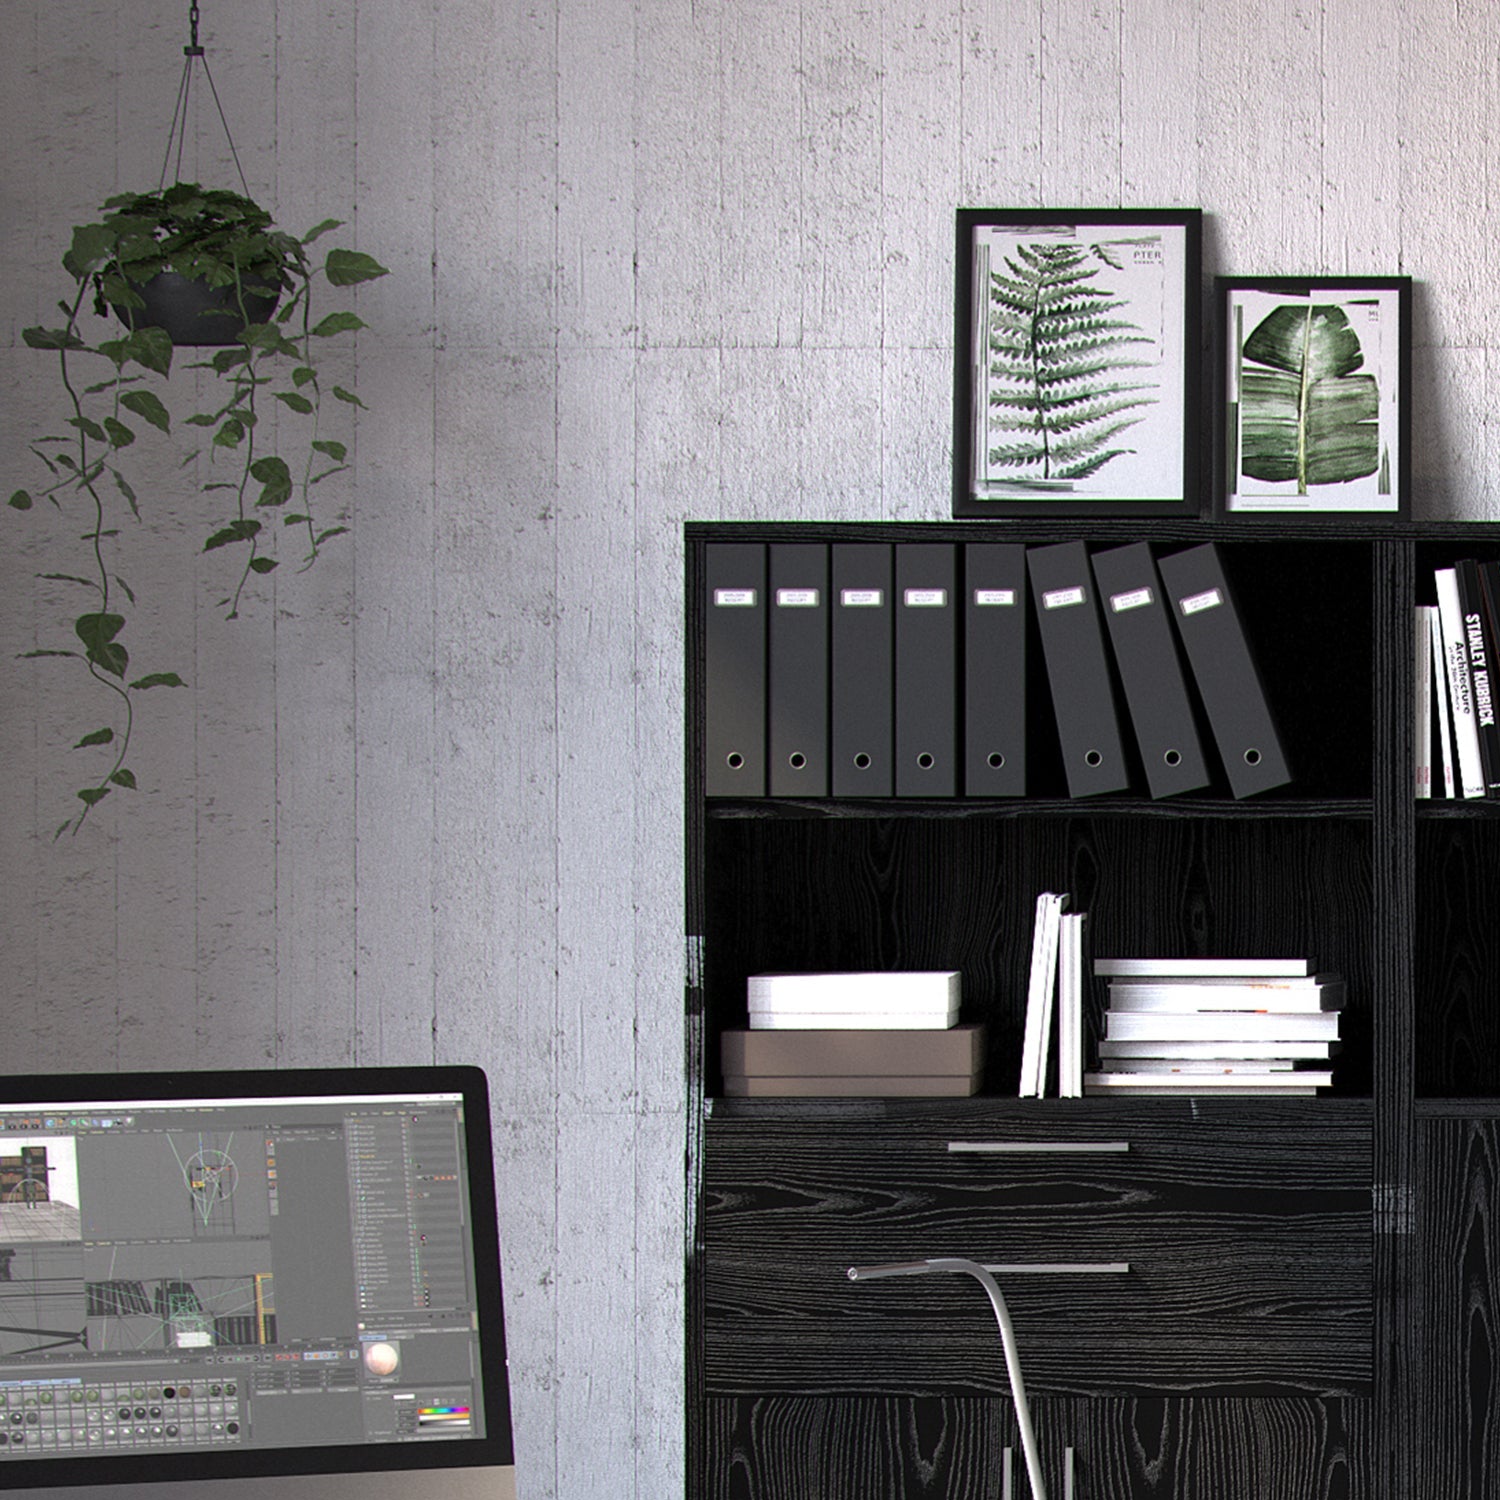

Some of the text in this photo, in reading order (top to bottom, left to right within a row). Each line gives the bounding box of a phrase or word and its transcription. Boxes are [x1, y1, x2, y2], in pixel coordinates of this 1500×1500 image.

[1454, 641, 1470, 714] Architecture
[1466, 614, 1494, 727] STANLEY KUBRICK
